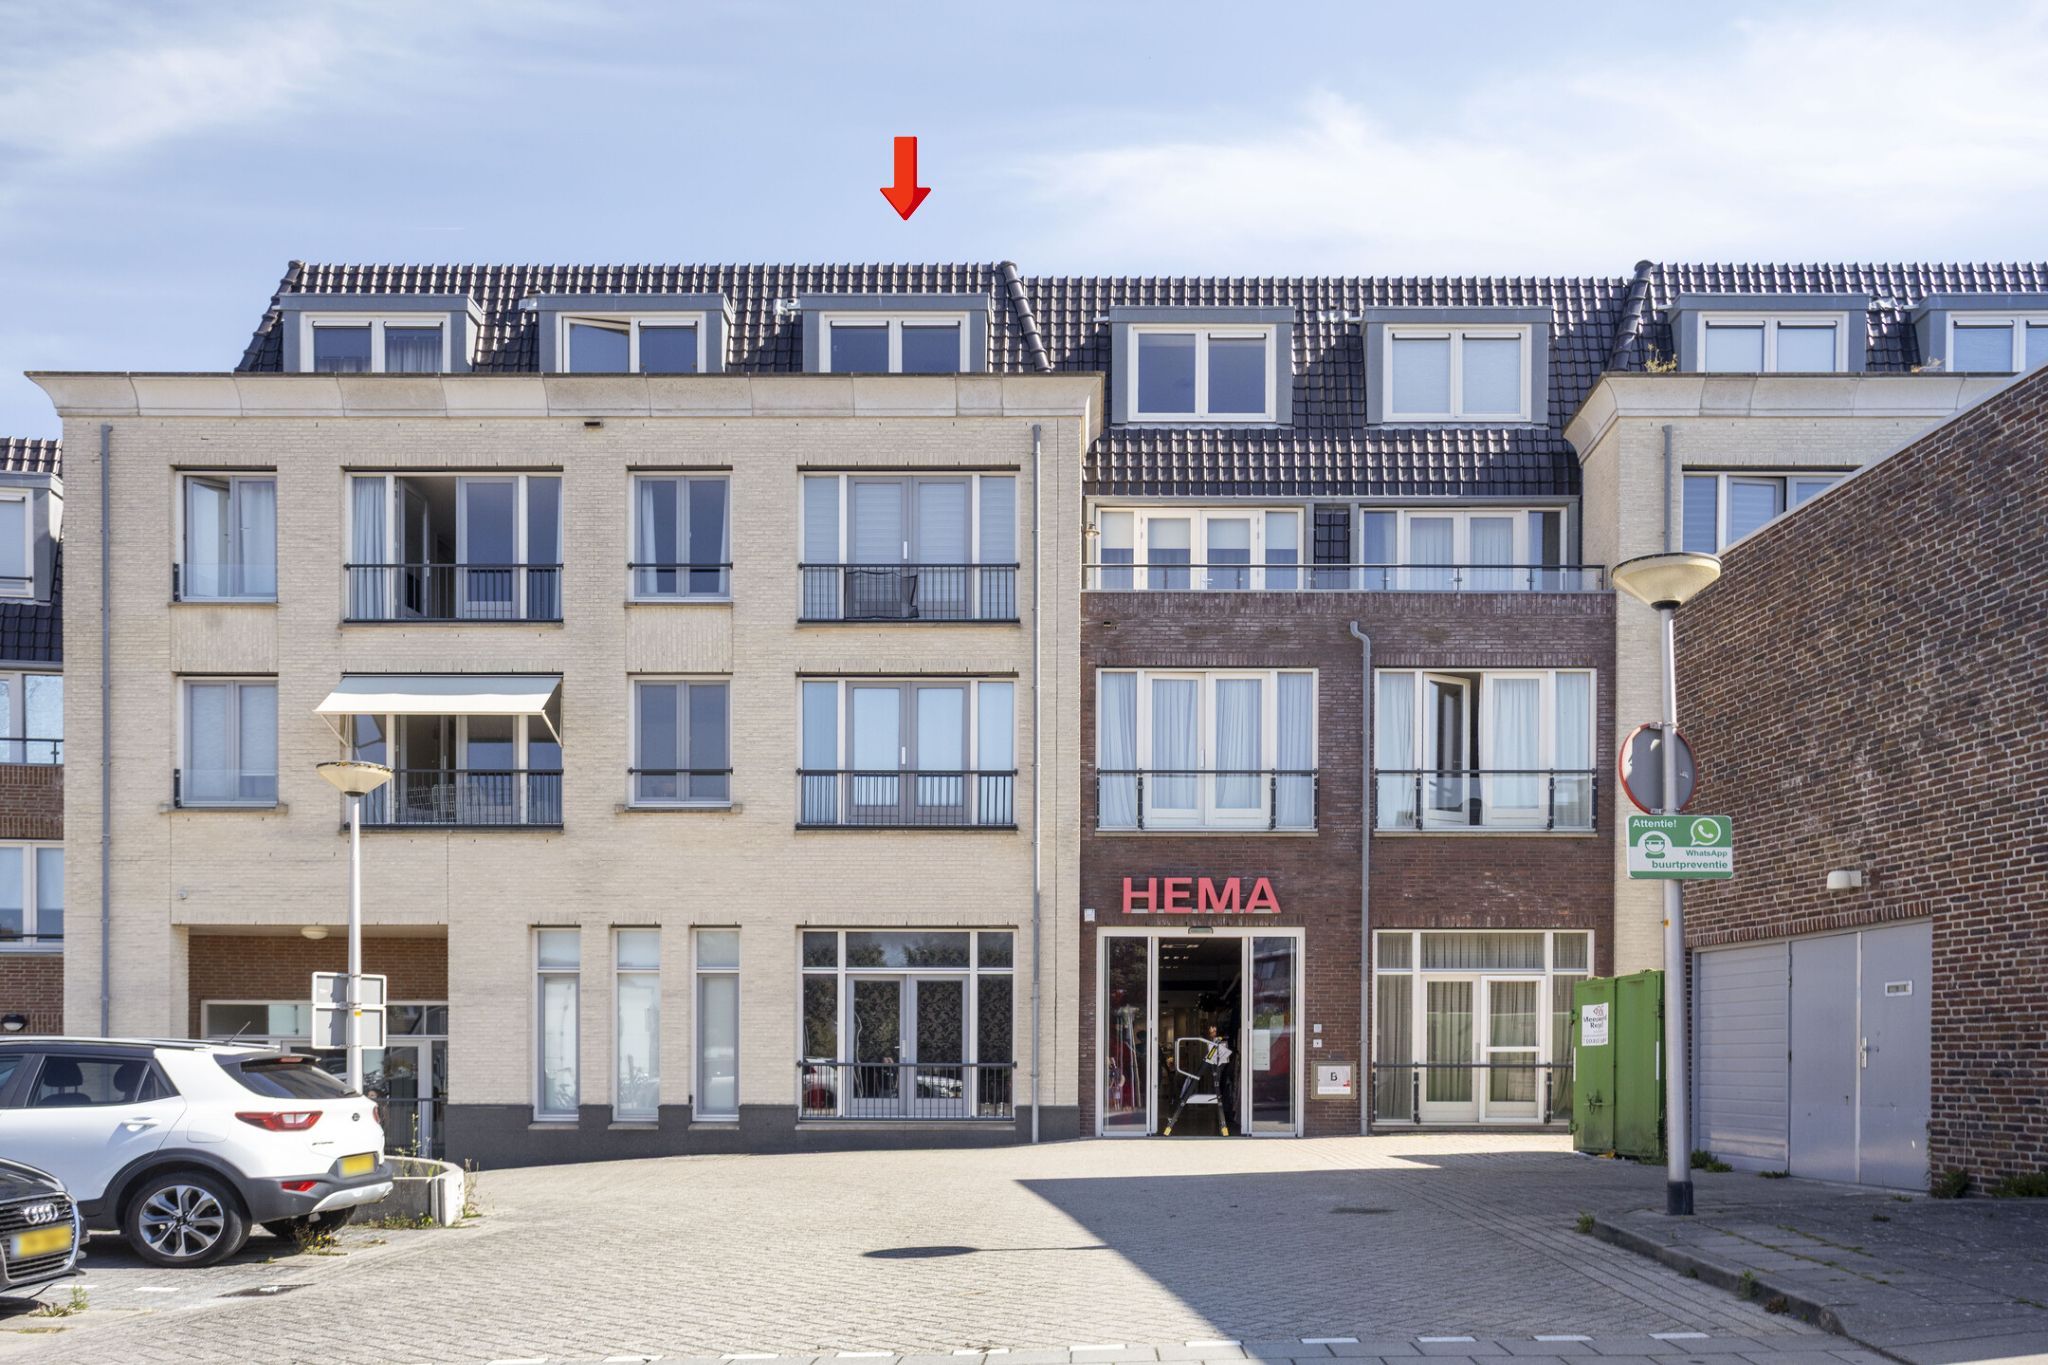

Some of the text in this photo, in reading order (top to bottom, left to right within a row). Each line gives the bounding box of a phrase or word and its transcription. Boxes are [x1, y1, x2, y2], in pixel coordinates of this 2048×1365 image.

[1632, 819, 1677, 828] Attentie!
[1685, 849, 1728, 858] WhatsApp
[1651, 861, 1728, 870] buurtpreventie
[1122, 877, 1281, 913] HEMA
